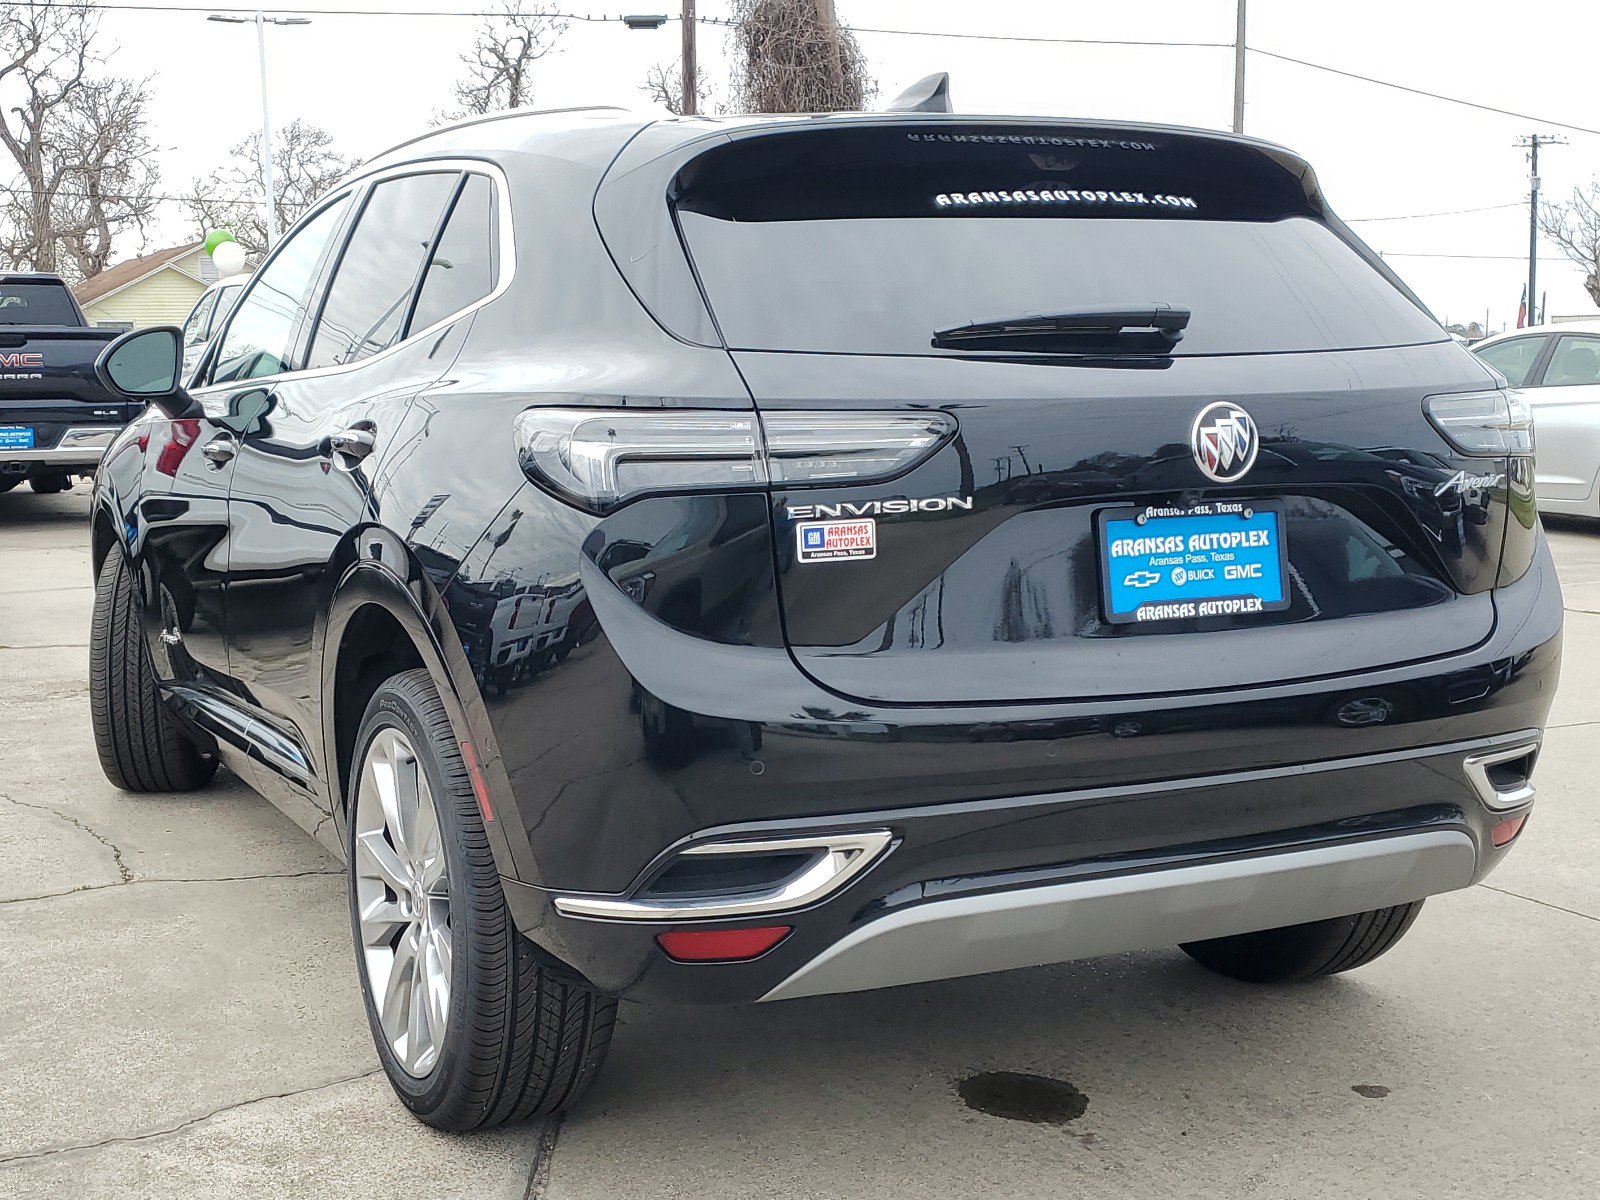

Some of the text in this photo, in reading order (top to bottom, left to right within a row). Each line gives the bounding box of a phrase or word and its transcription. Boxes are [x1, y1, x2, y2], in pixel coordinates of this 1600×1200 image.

[935, 190, 1198, 209] ARANSASAUTOPLEX.COM
[0, 353, 43, 367] MC
[786, 496, 974, 520] ENVISION
[1215, 502, 1243, 513] Texas
[807, 531, 821, 545] GM
[827, 525, 869, 538] ARANSAS
[826, 536, 871, 549] AUTOPLEX
[1111, 529, 1270, 558] ARANSAS AUTOPLEX
[1149, 552, 1235, 566] Aransas Pass, Texas
[1187, 563, 1263, 581] BUICK GMC
[1136, 598, 1263, 622] ARANSAS AUTOPLEX
